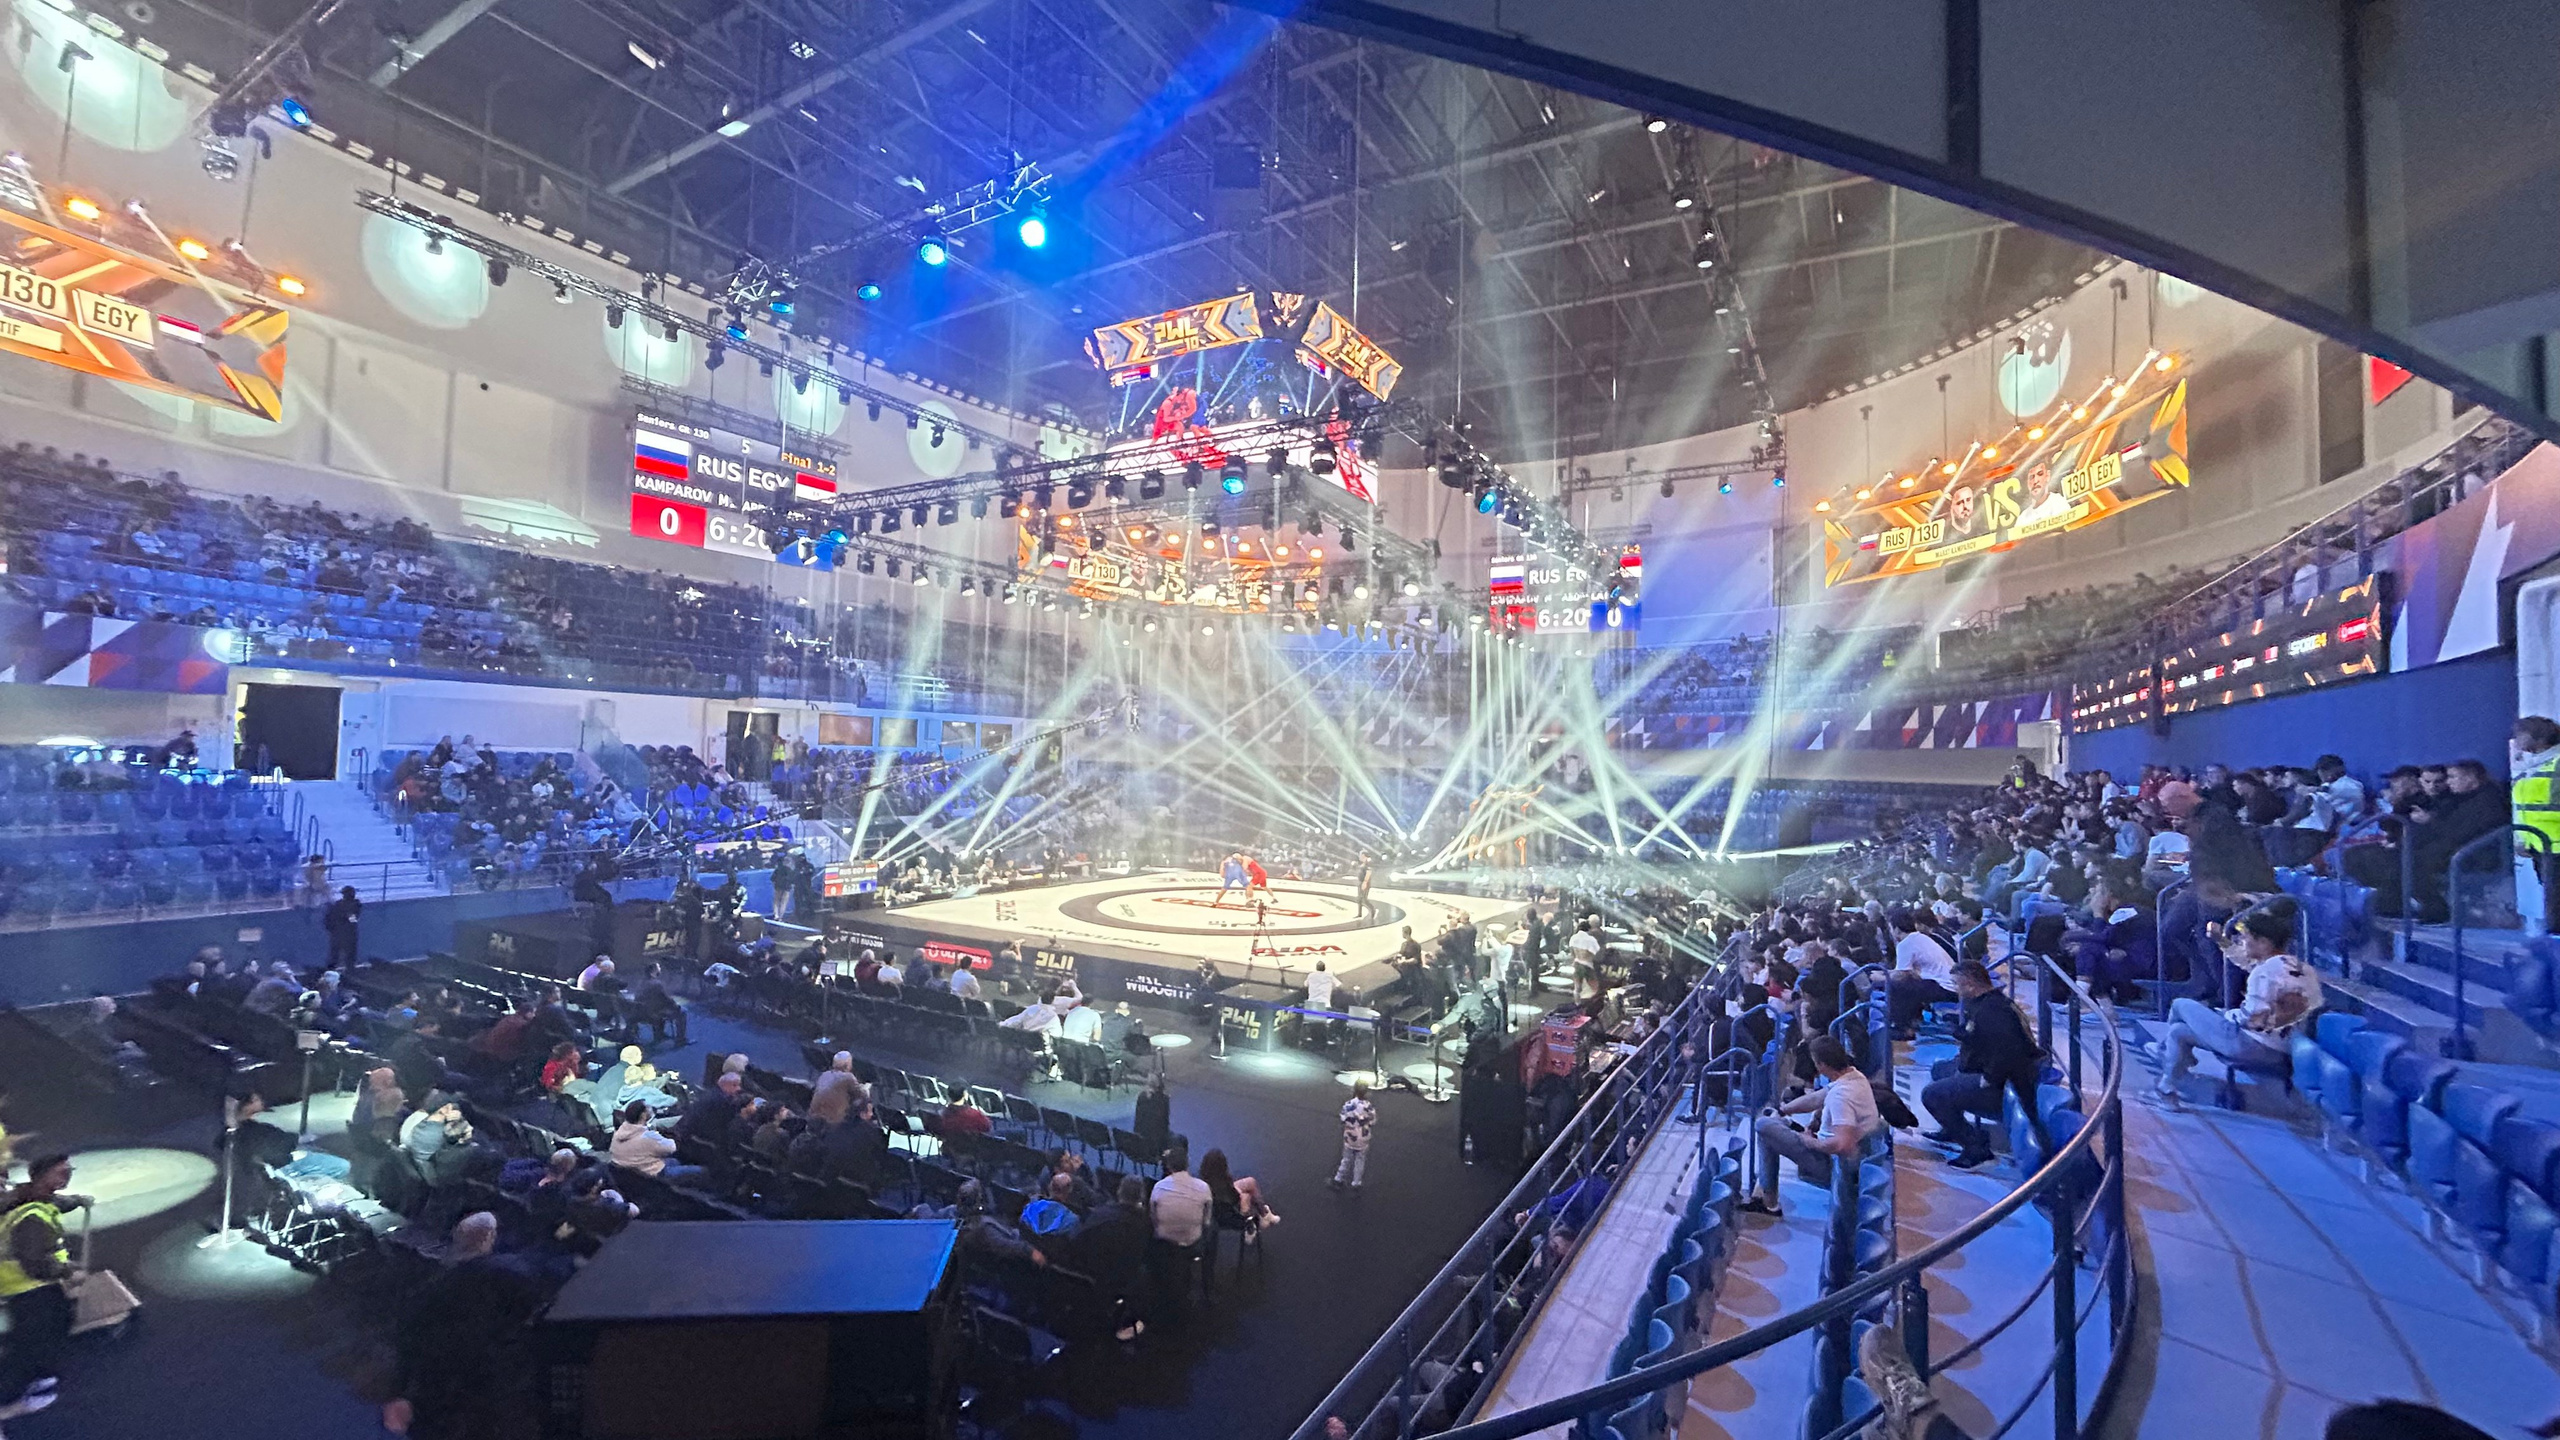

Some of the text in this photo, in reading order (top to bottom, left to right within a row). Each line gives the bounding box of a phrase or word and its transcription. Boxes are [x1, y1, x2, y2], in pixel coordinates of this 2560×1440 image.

[0, 270, 139, 332] 130 EGY
[1154, 315, 1199, 344] PWL
[693, 427, 710, 440] 130
[741, 440, 751, 454] 5
[696, 454, 742, 483] RUS
[781, 452, 836, 477] Final 1-2
[634, 474, 713, 503] KAMPAROV
[2067, 459, 2115, 496] 130 EGY
[1982, 477, 2021, 531] VS
[660, 507, 679, 536] 0
[1885, 523, 1939, 548] RUS 130
[1098, 565, 1116, 579] 130
[1528, 569, 1560, 585] RUS
[1538, 608, 1588, 627] 6:20
[1221, 1006, 1261, 1028] PWL
[1246, 1027, 1260, 1040] 10
